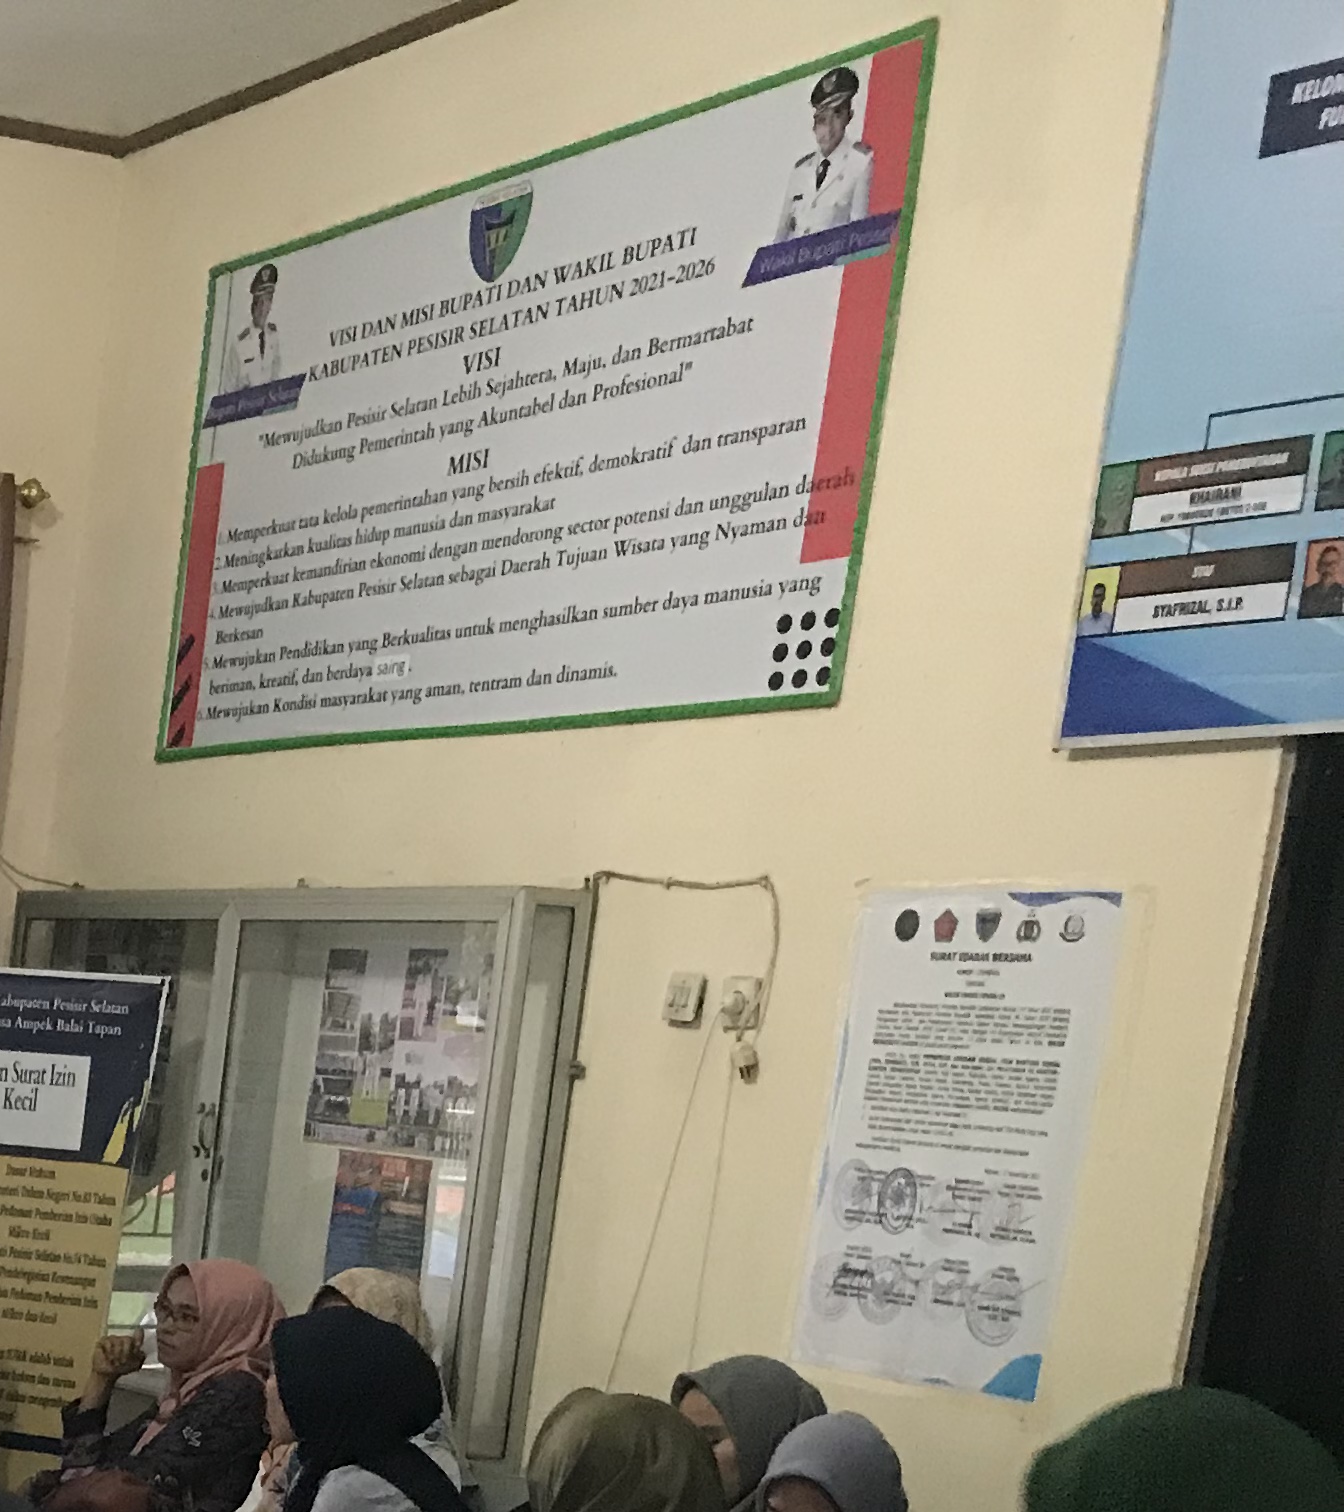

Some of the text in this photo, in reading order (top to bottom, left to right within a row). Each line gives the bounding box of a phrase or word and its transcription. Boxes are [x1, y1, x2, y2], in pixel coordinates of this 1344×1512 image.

[329, 226, 698, 347] VISI DAN MISI BUPATI DAN WAKIL BUPATI
[308, 256, 717, 382] KABUPATEN PESISIR SELATAN TAHUN 2021-2026
[346, 406, 388, 430] Pesisir
[390, 396, 438, 420] Selatan
[442, 380, 482, 407] Lebih
[611, 344, 642, 366] dan
[647, 316, 754, 357] Bermartabat
[462, 346, 502, 375] VISI
[291, 442, 356, 469] Didukung
[359, 422, 436, 454] Pemerintah
[439, 417, 475, 442] yang
[477, 392, 556, 429] Akuntabel
[558, 388, 587, 410] dan
[298, 514, 320, 530] tata
[322, 503, 358, 525] kelola
[360, 489, 448, 523] pemerintahan
[451, 484, 486, 505] yang
[488, 468, 530, 494] bersih
[588, 436, 678, 474] demokratif
[682, 434, 712, 455] dan
[716, 417, 807, 448] transparan
[446, 447, 490, 477] MISI
[292, 556, 367, 583] kemandirian
[369, 545, 427, 569] ekonomi
[429, 540, 478, 562] dengan
[481, 526, 564, 551] mendorong
[567, 515, 611, 536] sector
[613, 500, 670, 535] potensi
[674, 497, 704, 517] dan
[709, 481, 790, 515] unggulan
[795, 466, 856, 496] daerah
[306, 532, 353, 554] kualitas
[355, 524, 391, 546] hidup
[393, 513, 446, 539] manusia
[449, 510, 474, 529] dan
[477, 495, 556, 525] masyarakat
[291, 588, 355, 609] Kabupaten
[357, 580, 397, 599] Pesisir
[399, 573, 445, 593] Selatan
[448, 560, 497, 587] sebagai
[500, 552, 551, 577] Daerah
[556, 546, 609, 571] Tujuan
[613, 537, 665, 558] Wisata
[670, 530, 710, 554] yang
[714, 517, 788, 545] Nyaman
[792, 507, 826, 528] dan
[214, 627, 264, 645] Berkesan
[279, 640, 345, 662] Pendidikan
[347, 637, 379, 656] yang
[380, 625, 452, 650] Berkualitas
[455, 616, 496, 639] untuk
[498, 605, 598, 635] menghasilkan
[602, 595, 660, 619] sumber
[662, 590, 699, 614] daya
[703, 579, 773, 606] manusia
[778, 575, 823, 601] yang
[272, 693, 318, 714] Kondisi
[320, 686, 388, 711] masyarakat
[390, 687, 423, 705] yang
[469, 675, 523, 694] tentram
[526, 668, 553, 688] dan
[301, 667, 324, 685] dan
[326, 662, 373, 683] berdaya
[14, 1016, 53, 1032] Ampek
[56, 1018, 84, 1033] Balai
[87, 1020, 123, 1038] Tapan
[89, 999, 130, 1015] Selatan
[2, 1087, 39, 1112] Kecil
[12, 1060, 47, 1085] Surat
[49, 1063, 77, 1088] Izin
